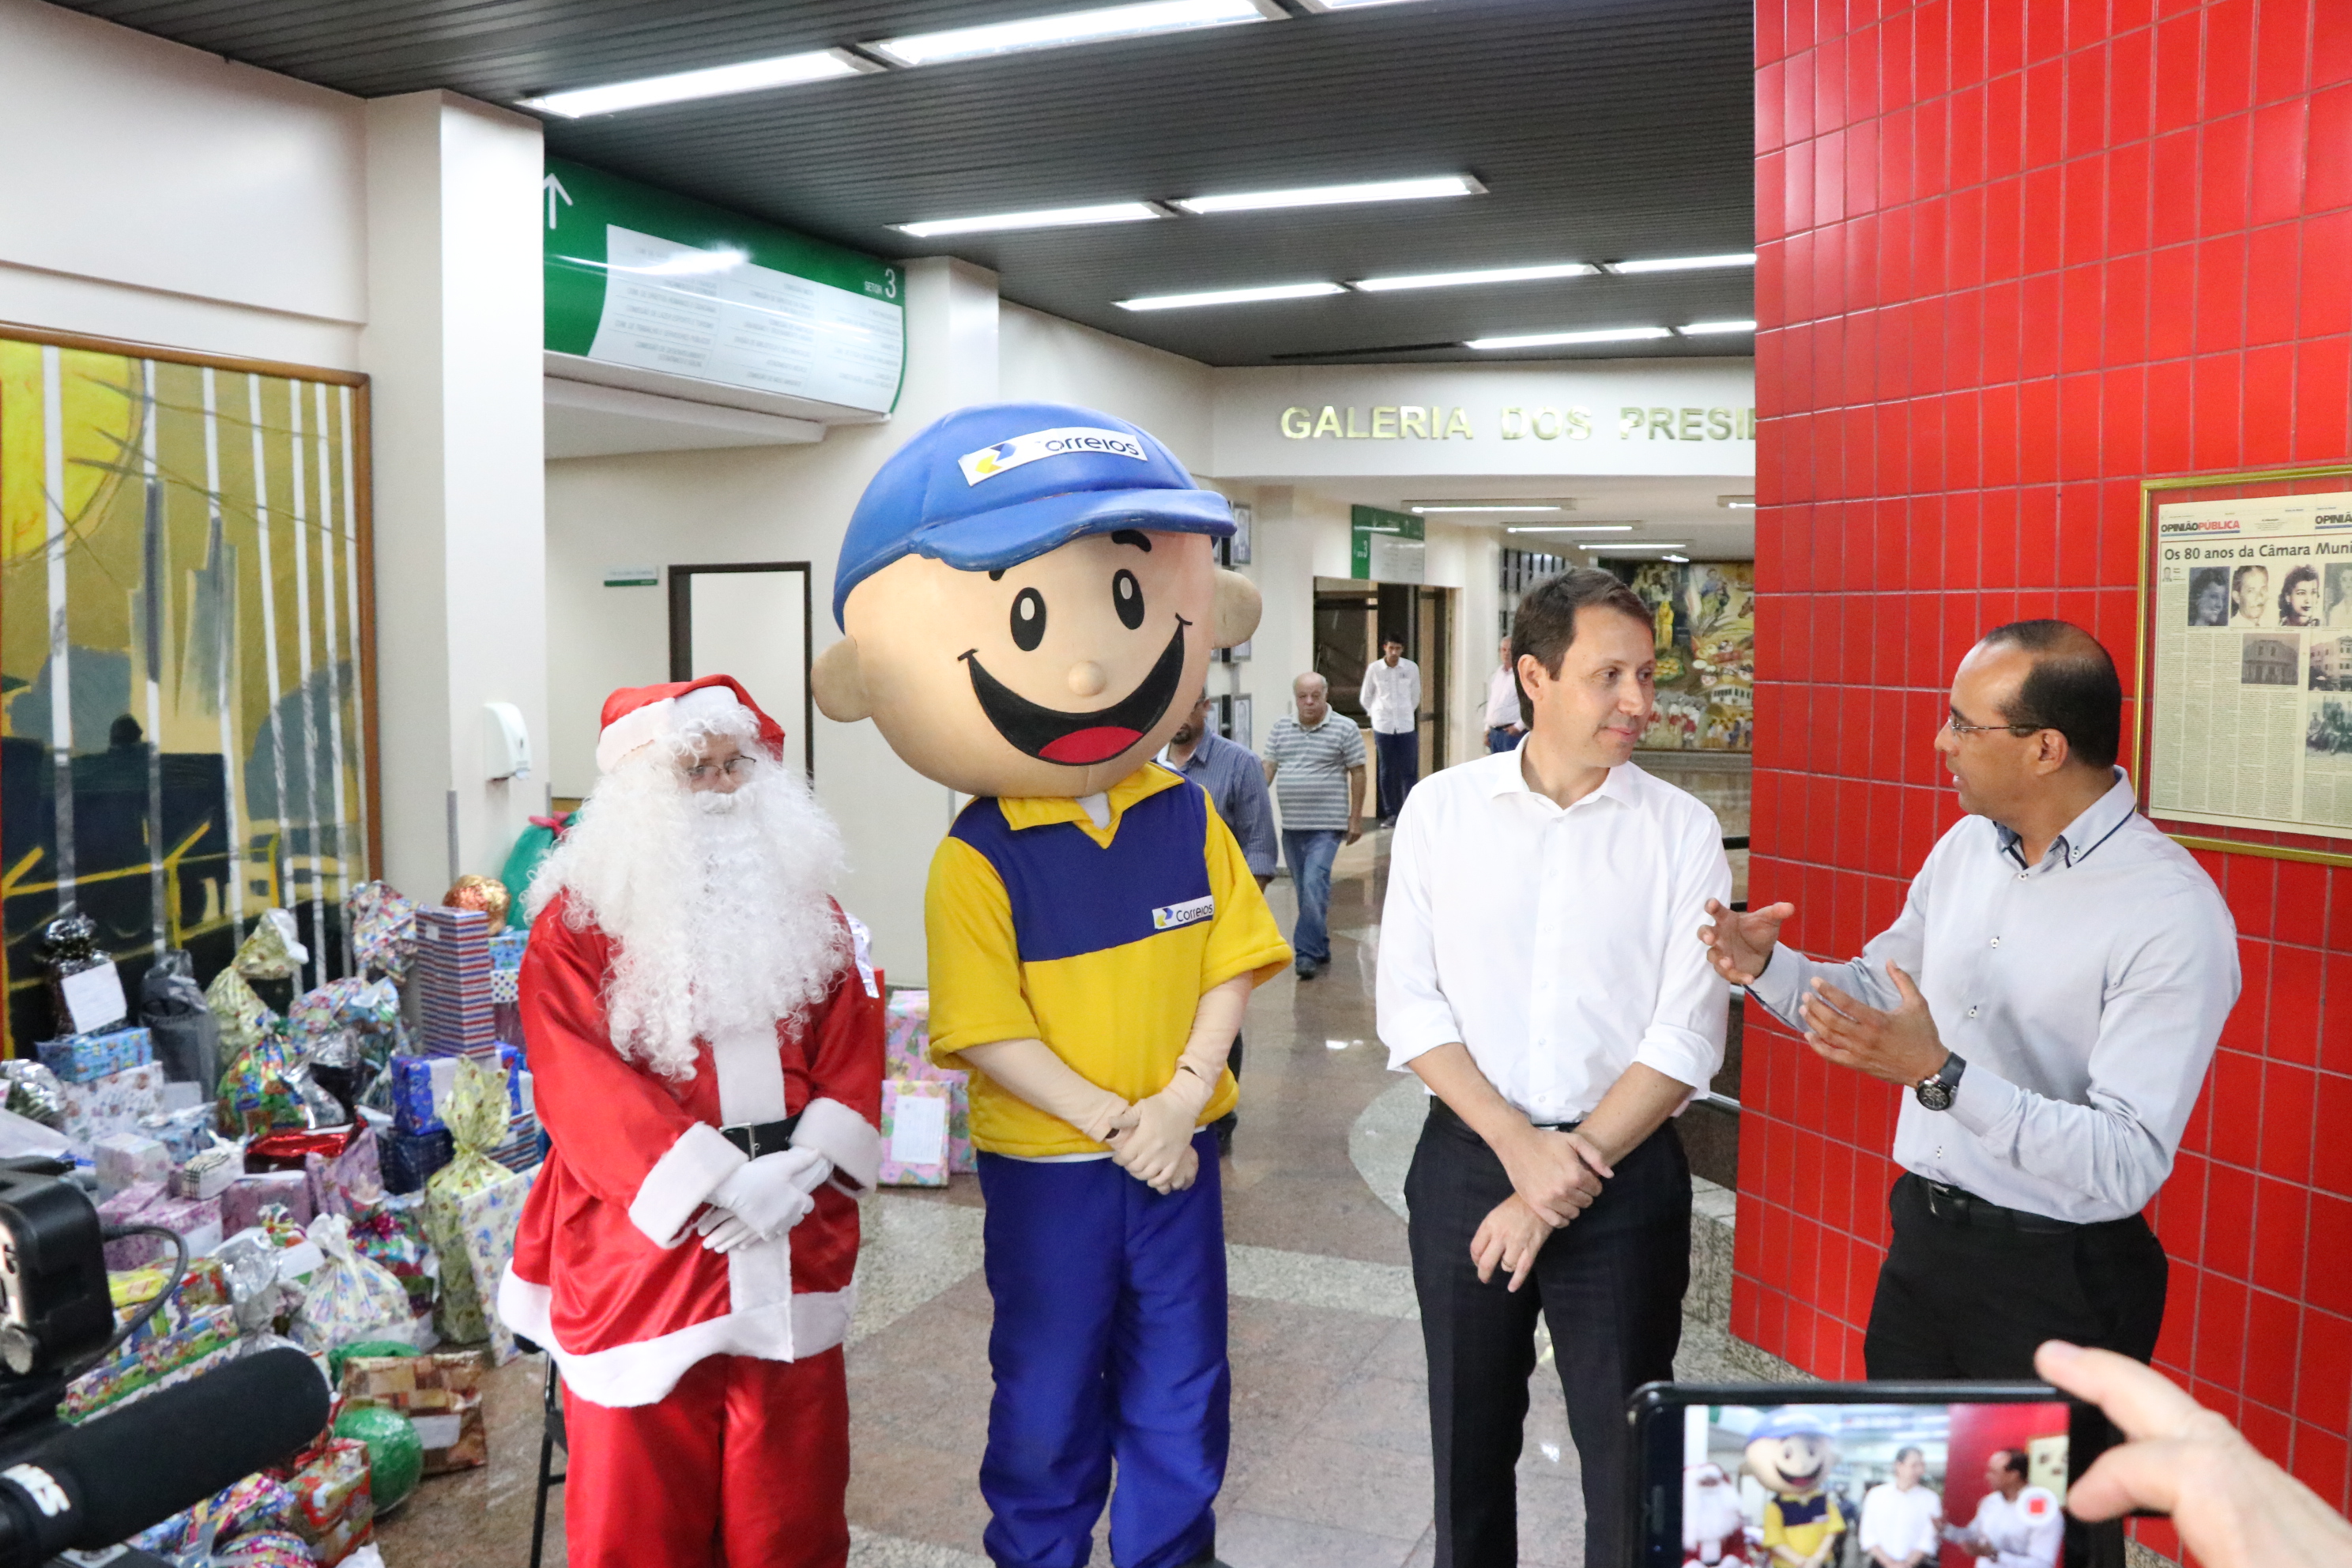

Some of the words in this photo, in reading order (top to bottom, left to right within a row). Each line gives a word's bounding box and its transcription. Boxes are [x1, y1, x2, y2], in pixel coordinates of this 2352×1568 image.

[885, 268, 896, 299] 3
[1280, 405, 1473, 439] GALERIA
[1501, 405, 1592, 440] DOS
[1620, 406, 1755, 441] PRESI
[1035, 437, 1139, 456] orreios
[2165, 548, 2180, 560] Os
[2184, 548, 2200, 560] 80
[2204, 548, 2233, 559] anos
[2238, 545, 2254, 557] da
[2259, 544, 2310, 557] Câmara
[1176, 904, 1213, 922] Correios
